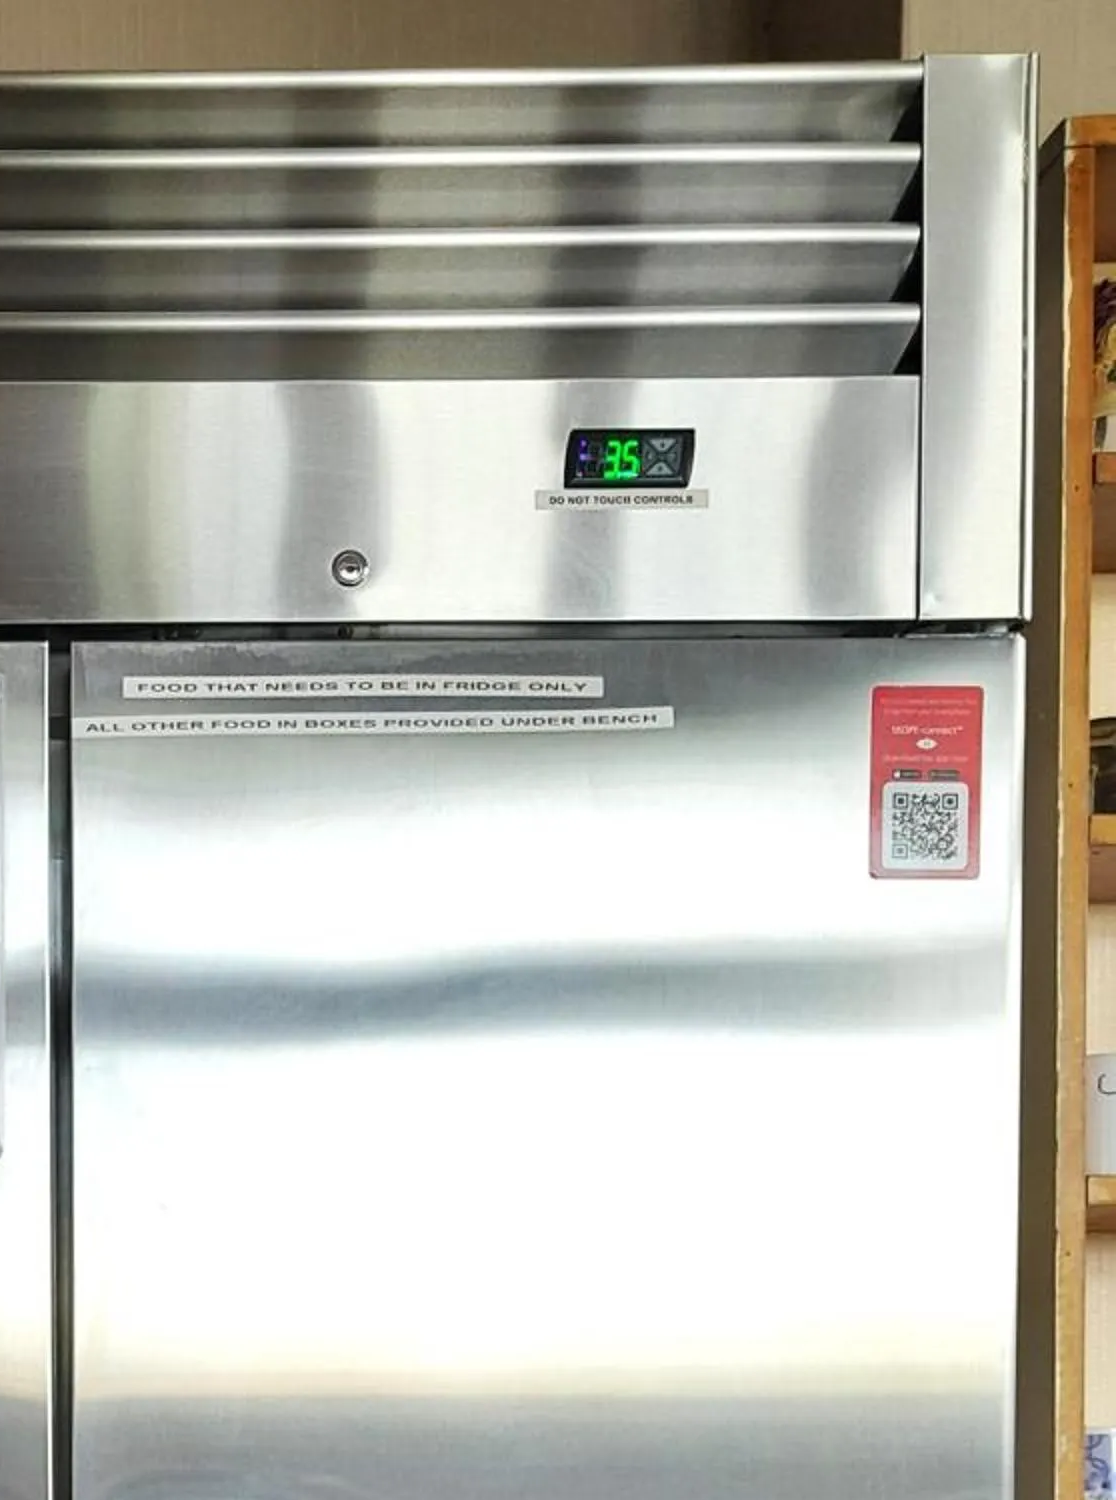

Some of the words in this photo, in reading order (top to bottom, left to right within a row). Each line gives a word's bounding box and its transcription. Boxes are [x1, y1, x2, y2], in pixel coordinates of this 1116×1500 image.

[549, 496, 565, 505] DO
[567, 496, 590, 505] NOT
[593, 496, 631, 505] TOUCH
[634, 496, 694, 505] CONTROLS
[137, 683, 199, 693] FOOD
[206, 683, 259, 693] THAT
[265, 682, 338, 692] NEEDS
[346, 681, 374, 691] TO
[380, 681, 409, 691] BE
[416, 681, 436, 690] IN
[443, 681, 521, 691] FRIDGE
[528, 681, 587, 692] ONLY
[86, 722, 124, 732] ALL
[131, 720, 204, 731] OTHER
[211, 719, 271, 729] FOOD
[277, 719, 298, 729] IN
[305, 719, 377, 729] BOXES
[384, 718, 493, 728] PROVIDED
[501, 716, 576, 727] UNDER
[582, 713, 658, 725] BENCH
